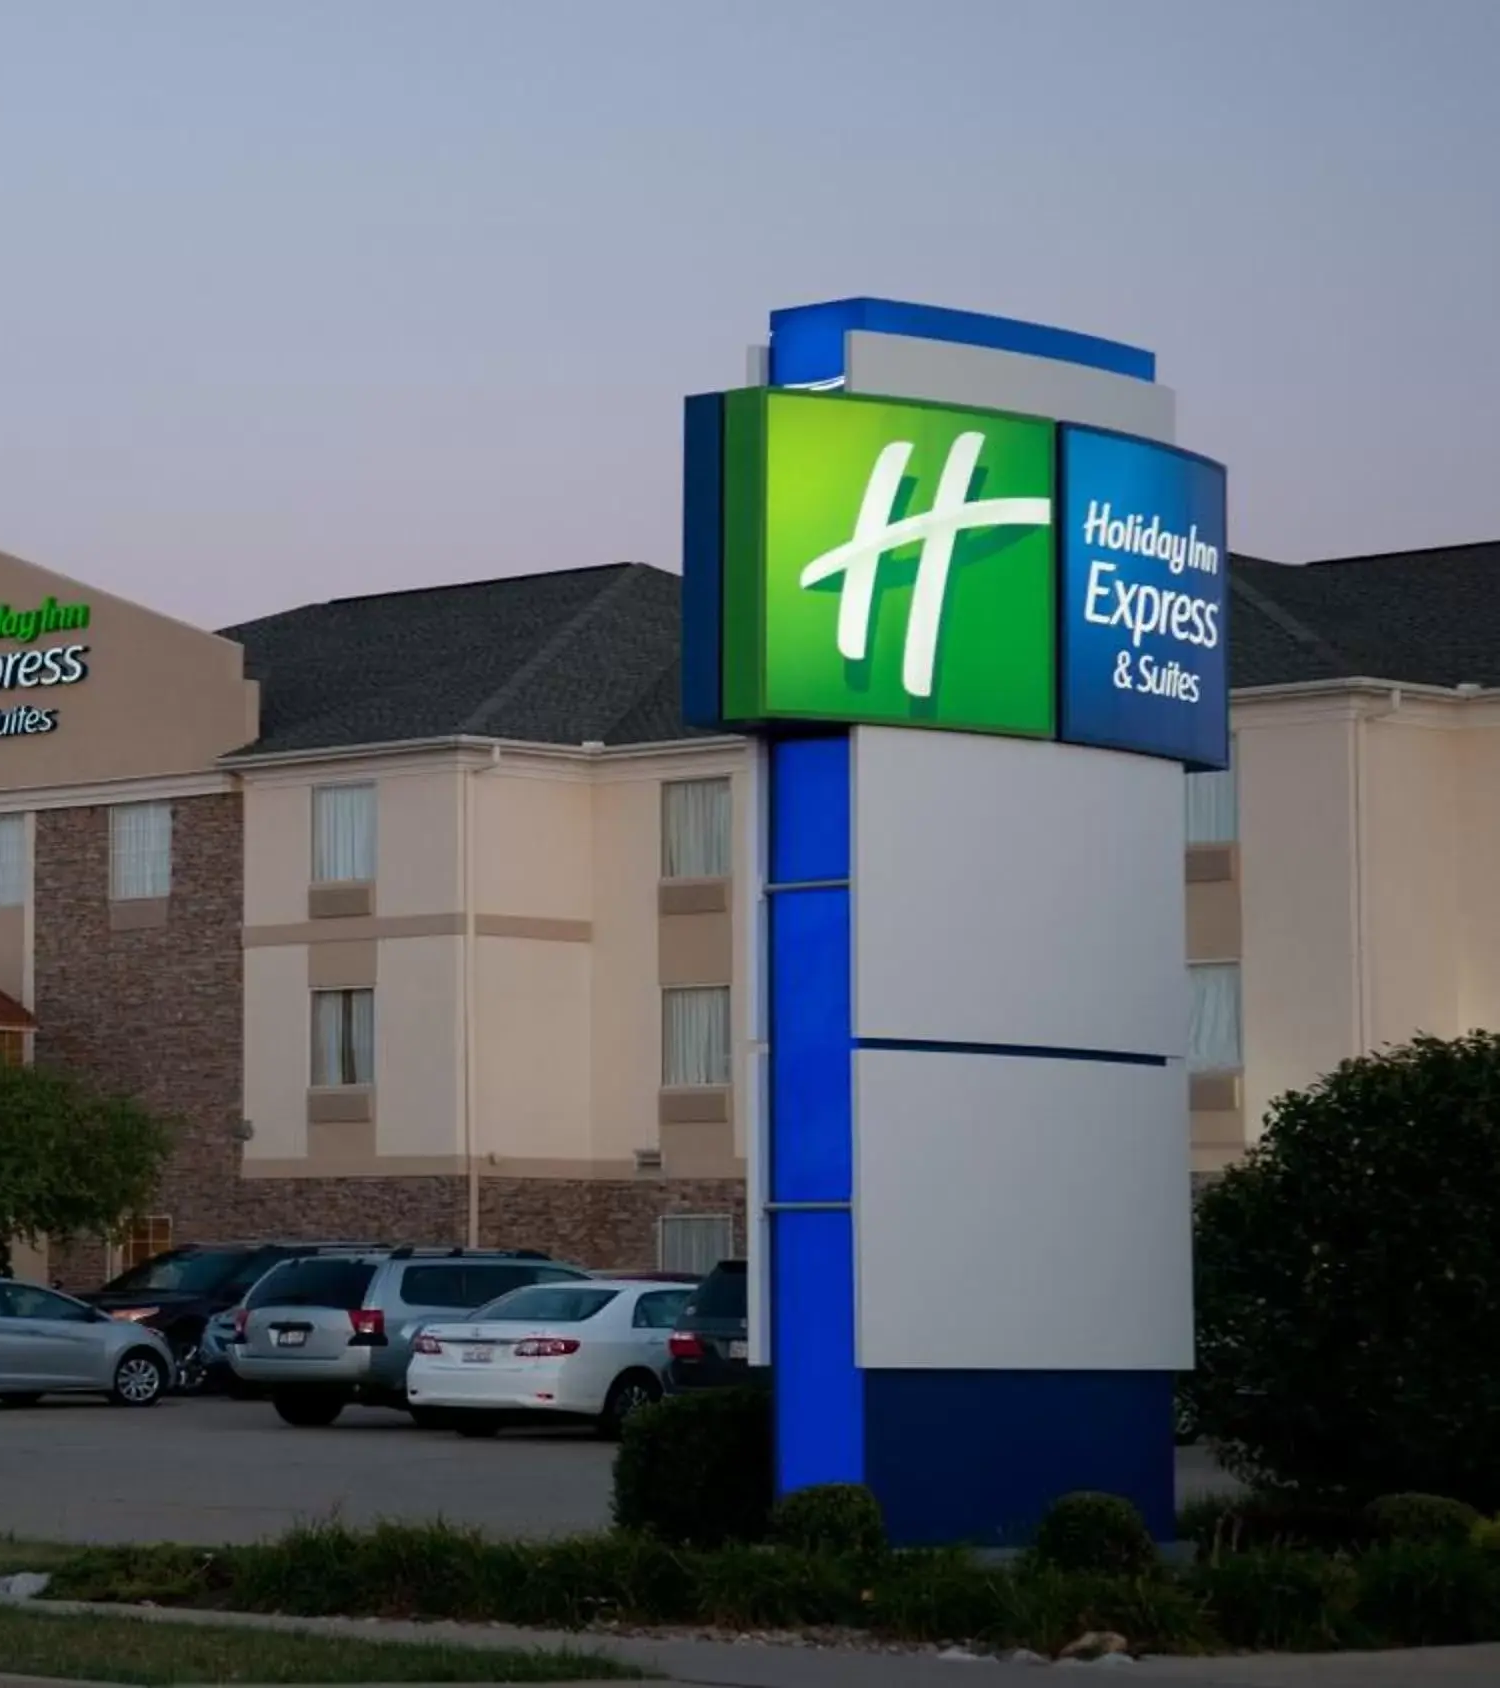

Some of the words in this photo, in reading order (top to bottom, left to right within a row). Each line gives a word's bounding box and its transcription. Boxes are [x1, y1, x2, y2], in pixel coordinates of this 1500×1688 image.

[1083, 499, 1186, 575] Holiday
[1187, 523, 1219, 566] Inn
[40, 596, 91, 635] Inn
[1084, 560, 1220, 649] Express
[1113, 650, 1133, 690] &
[1136, 654, 1201, 704] Suites
